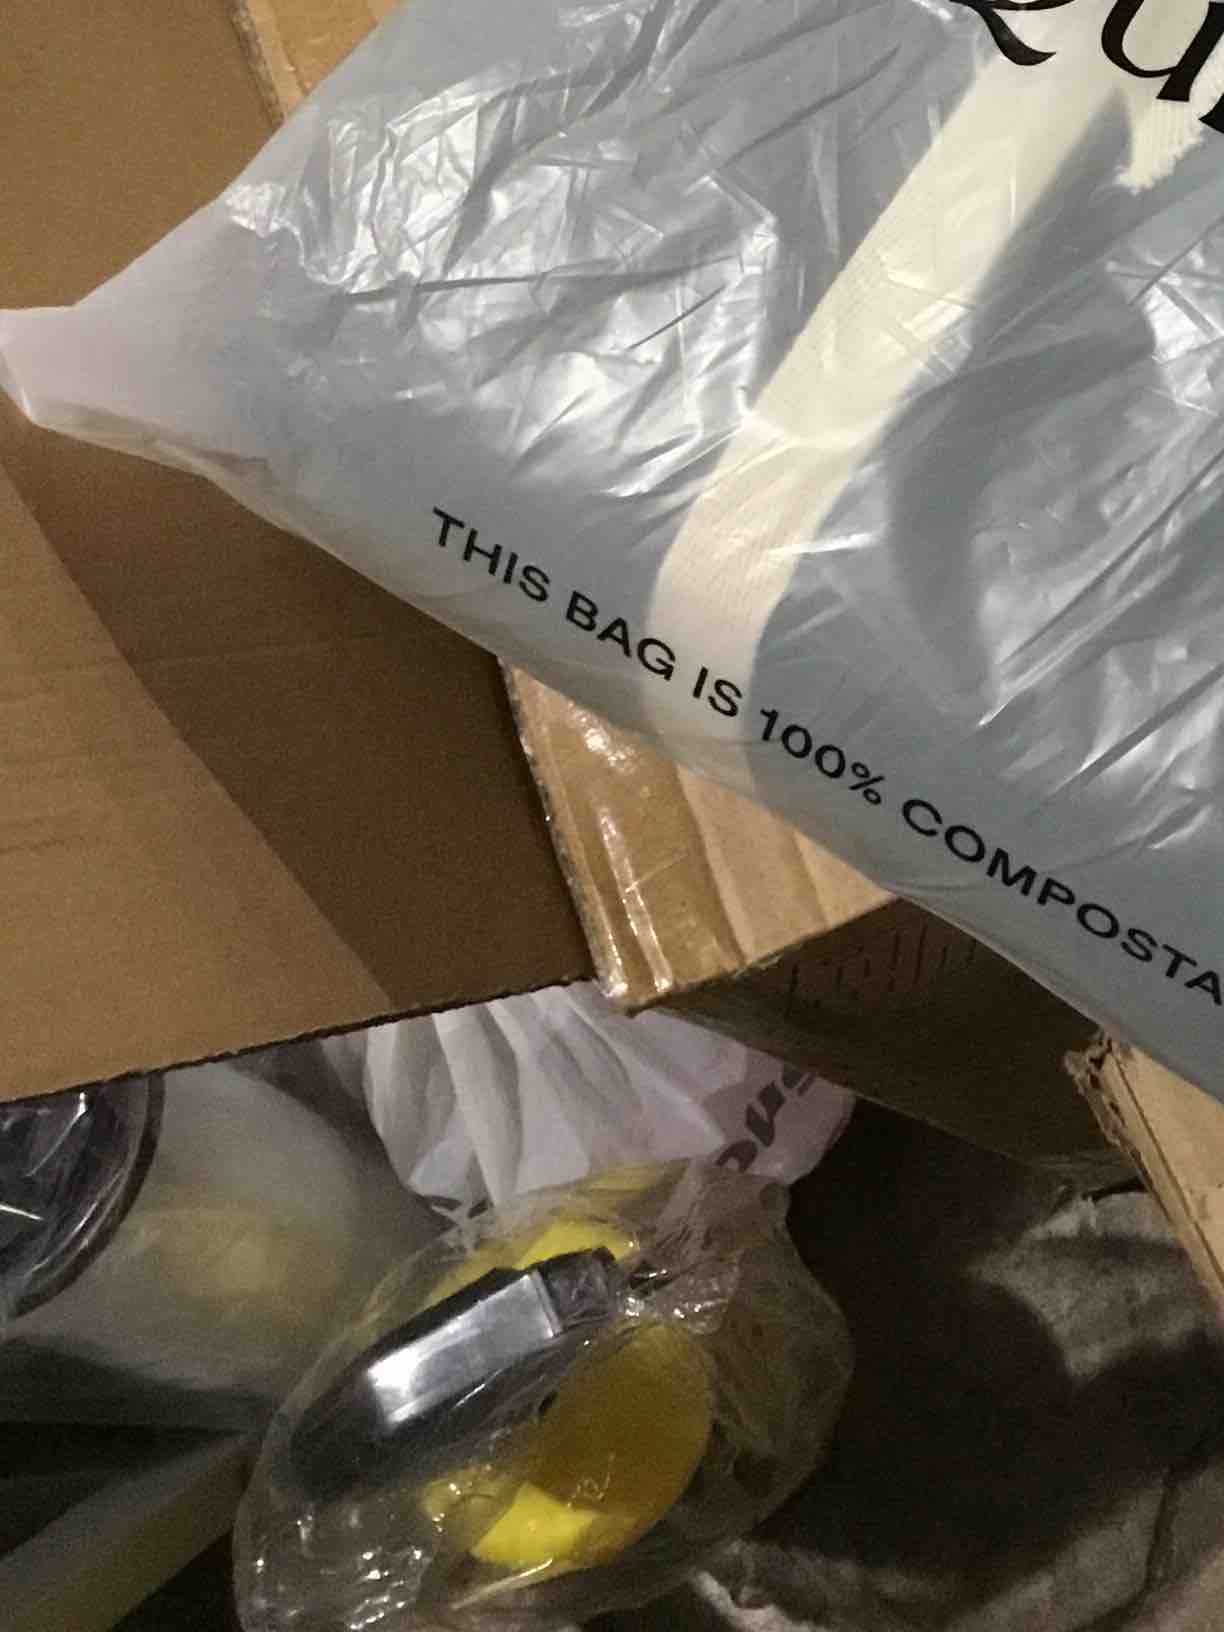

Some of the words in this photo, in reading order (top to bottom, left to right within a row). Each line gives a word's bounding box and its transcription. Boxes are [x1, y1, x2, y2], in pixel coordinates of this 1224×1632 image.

[432, 506, 551, 602] THIS
[565, 590, 677, 681] BAG
[692, 666, 743, 717] IS
[759, 708, 885, 805] 100%
